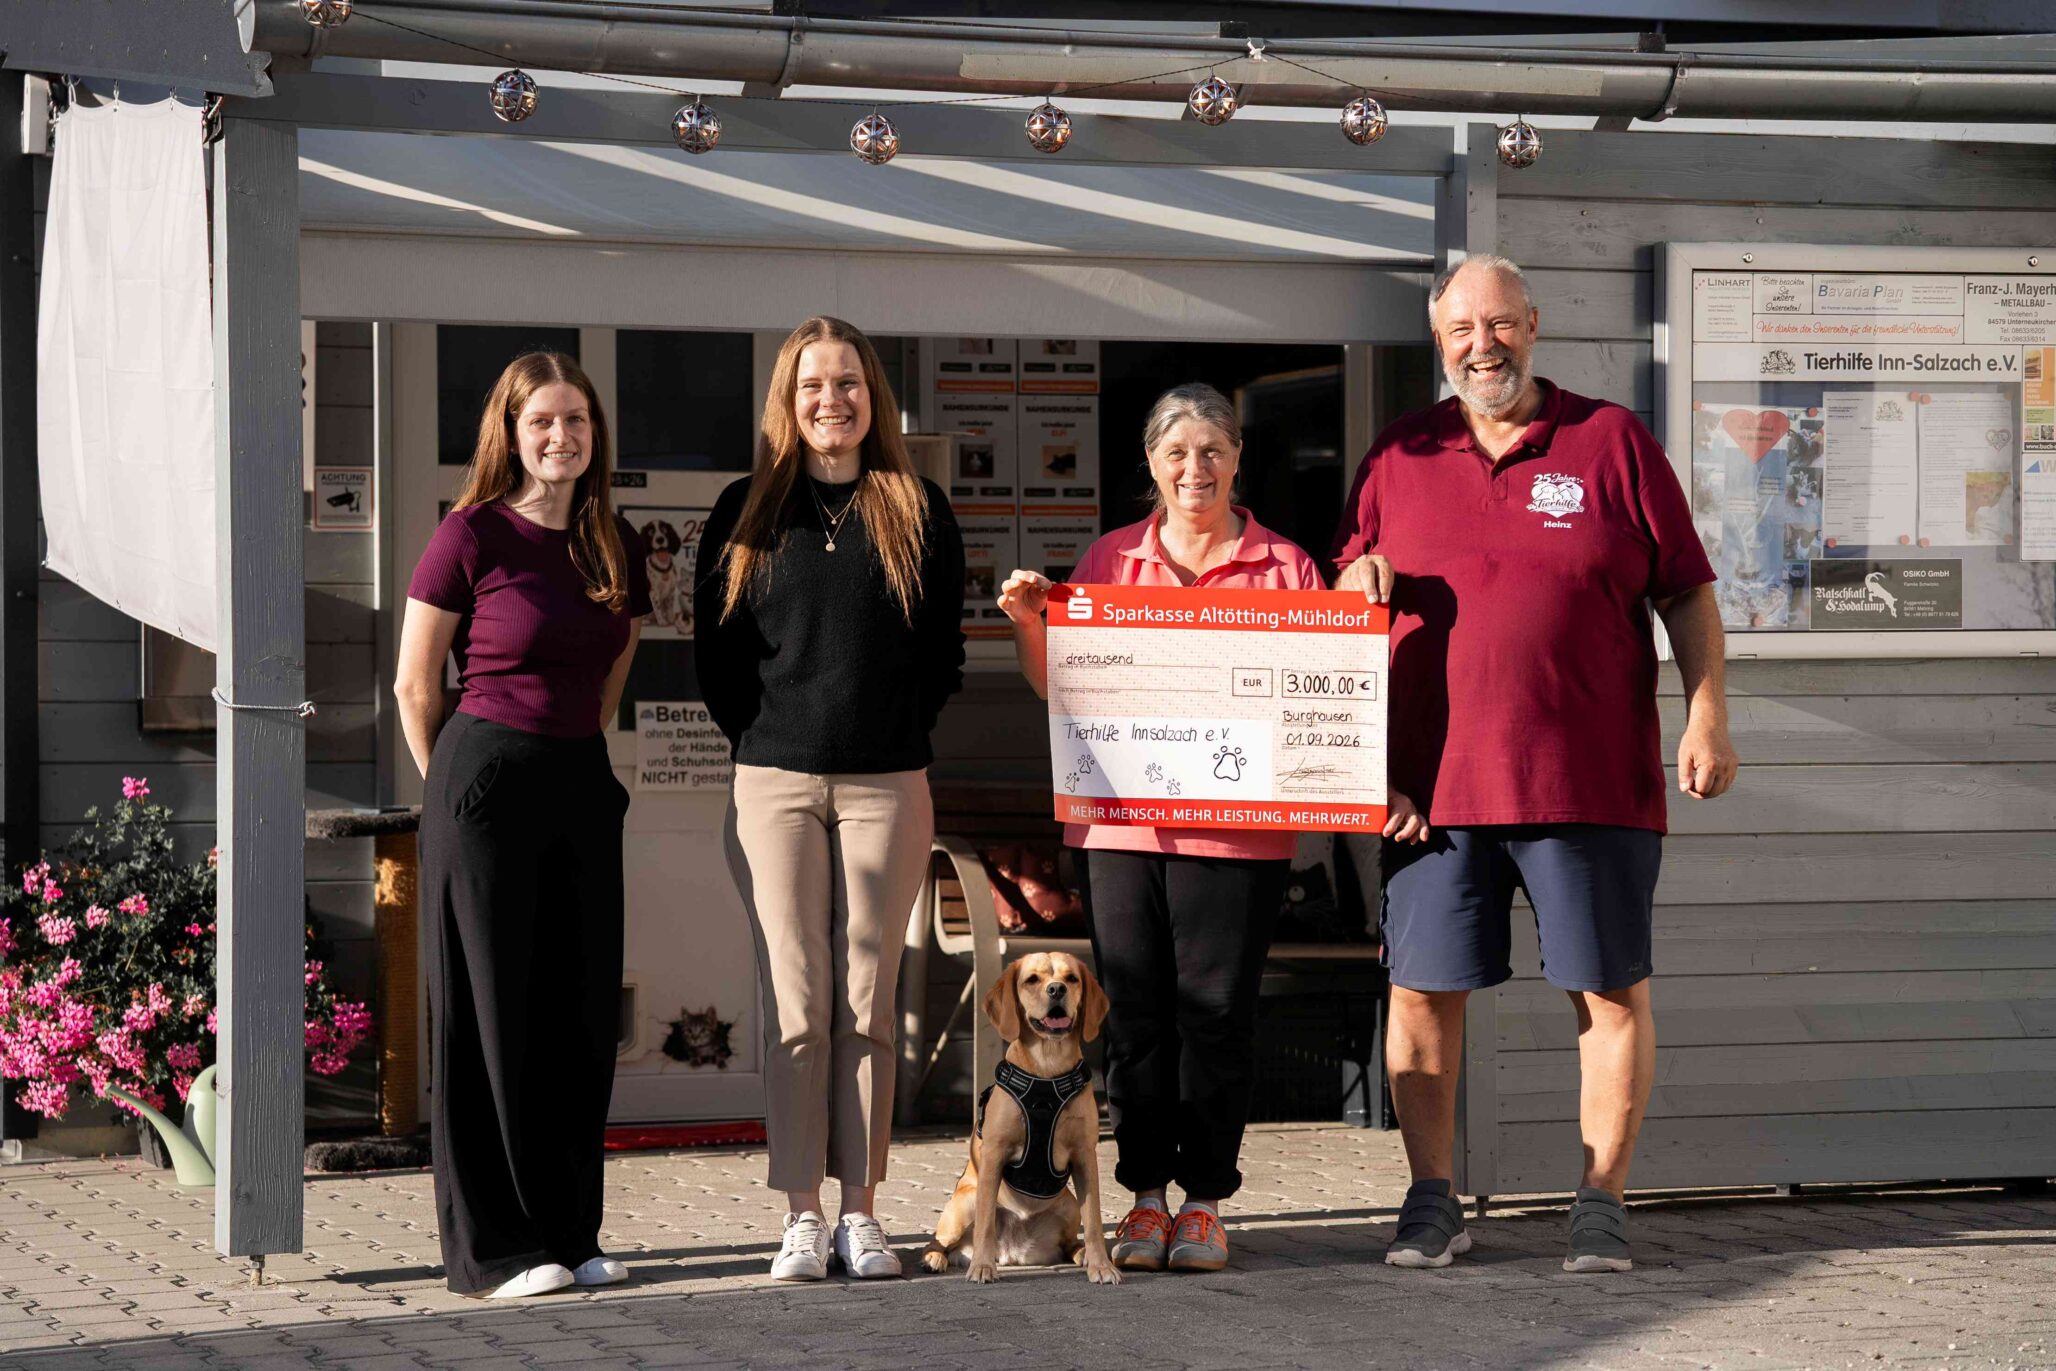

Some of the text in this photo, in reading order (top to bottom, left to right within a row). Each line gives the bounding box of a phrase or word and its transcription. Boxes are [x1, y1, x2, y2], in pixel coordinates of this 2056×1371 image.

[1707, 278, 1751, 287] LINHART
[1761, 276, 1805, 286] Bitte beachten
[1778, 286, 1789, 295] Sie
[1818, 284, 1904, 298] Bavaria Plan
[1967, 282, 2012, 295] Franz-J.
[1773, 294, 1795, 302] unsere
[2000, 299, 2045, 307] METALLBAU
[1765, 302, 1801, 312] Inserenten!
[1774, 322, 1798, 333] danken
[1800, 323, 1812, 333] den
[1804, 352, 2017, 371] Tierhilfe Inn-Salzach e.V.
[321, 473, 366, 481] ACHTUNG
[1533, 473, 1551, 485] 25
[1543, 520, 1573, 529] Heinz
[1903, 570, 1926, 578] OSIKO
[1103, 603, 1371, 629] Sparkasse Altötting-Mühldorf
[1066, 652, 1134, 665] dreitausend
[1243, 678, 1262, 687] EUR
[1286, 674, 1371, 695] 3.000,00 €
[656, 705, 713, 722] Betre
[1282, 706, 1353, 727] Burghausen
[645, 727, 724, 739] ohne Desinfe
[1063, 722, 1120, 742] Tierhilfe
[1286, 732, 1361, 748] 01.09.2026
[668, 742, 728, 753] der Hände
[647, 757, 668, 767] und
[641, 771, 688, 784] NICHT
[1070, 805, 1370, 826] MEHR MENSCH. MEHR LEISTUNG. MEHRWERT.
